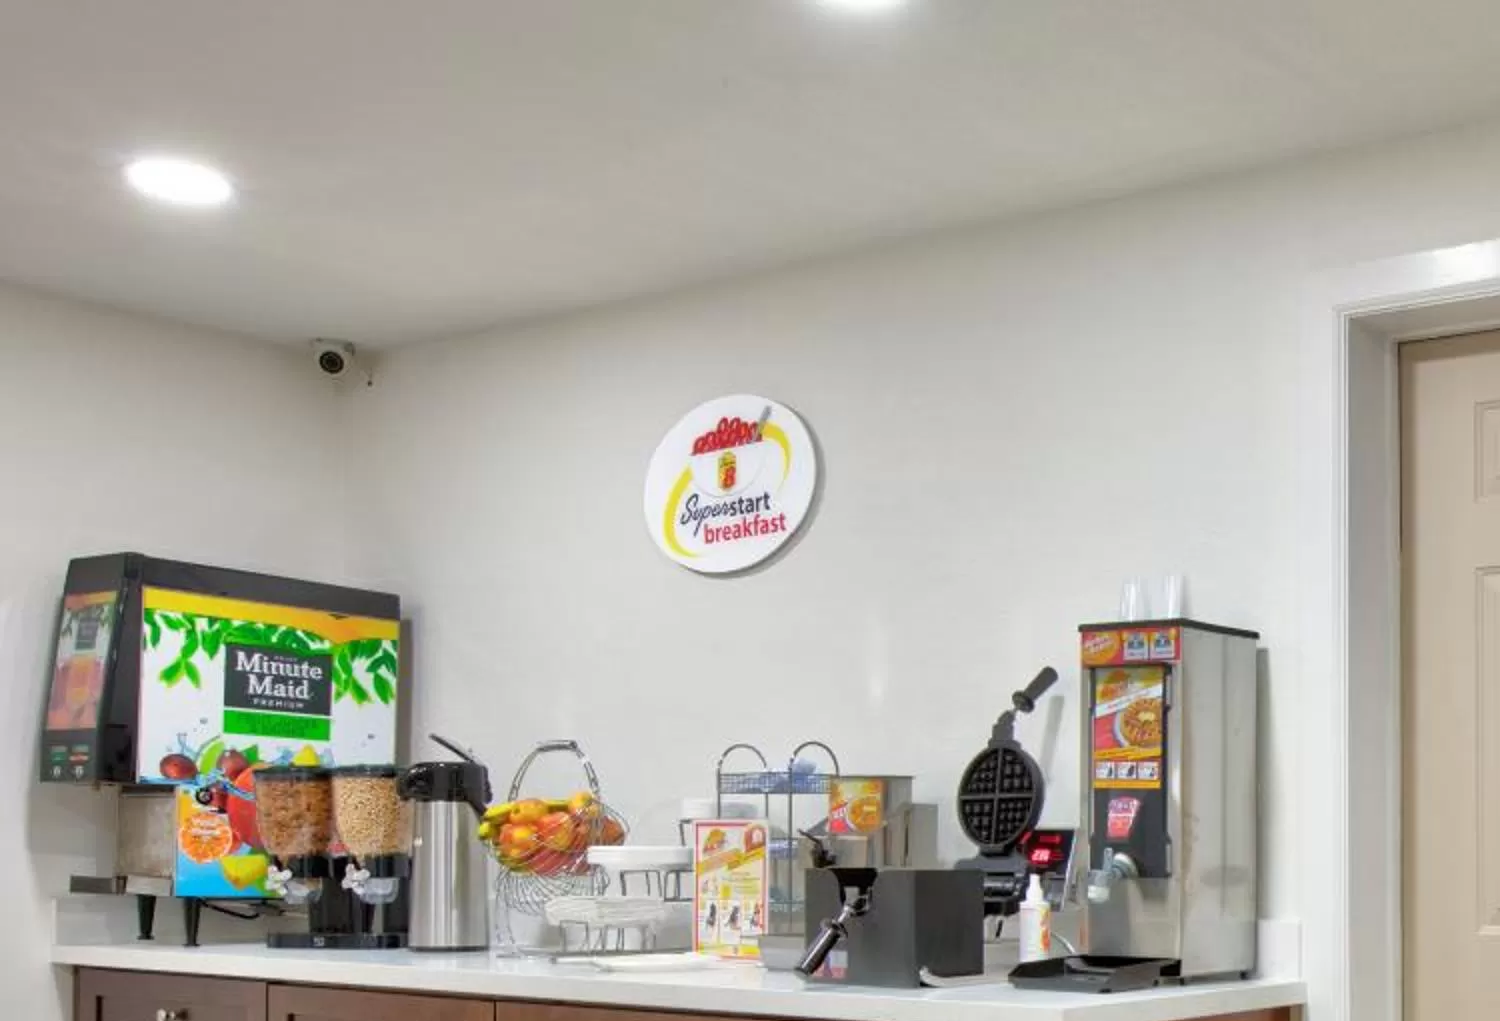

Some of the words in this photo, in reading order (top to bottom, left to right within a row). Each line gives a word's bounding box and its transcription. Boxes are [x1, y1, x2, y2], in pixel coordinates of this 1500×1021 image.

[703, 512, 787, 545] breakfast
[234, 650, 324, 680] Minute
[247, 673, 311, 700] Maid
